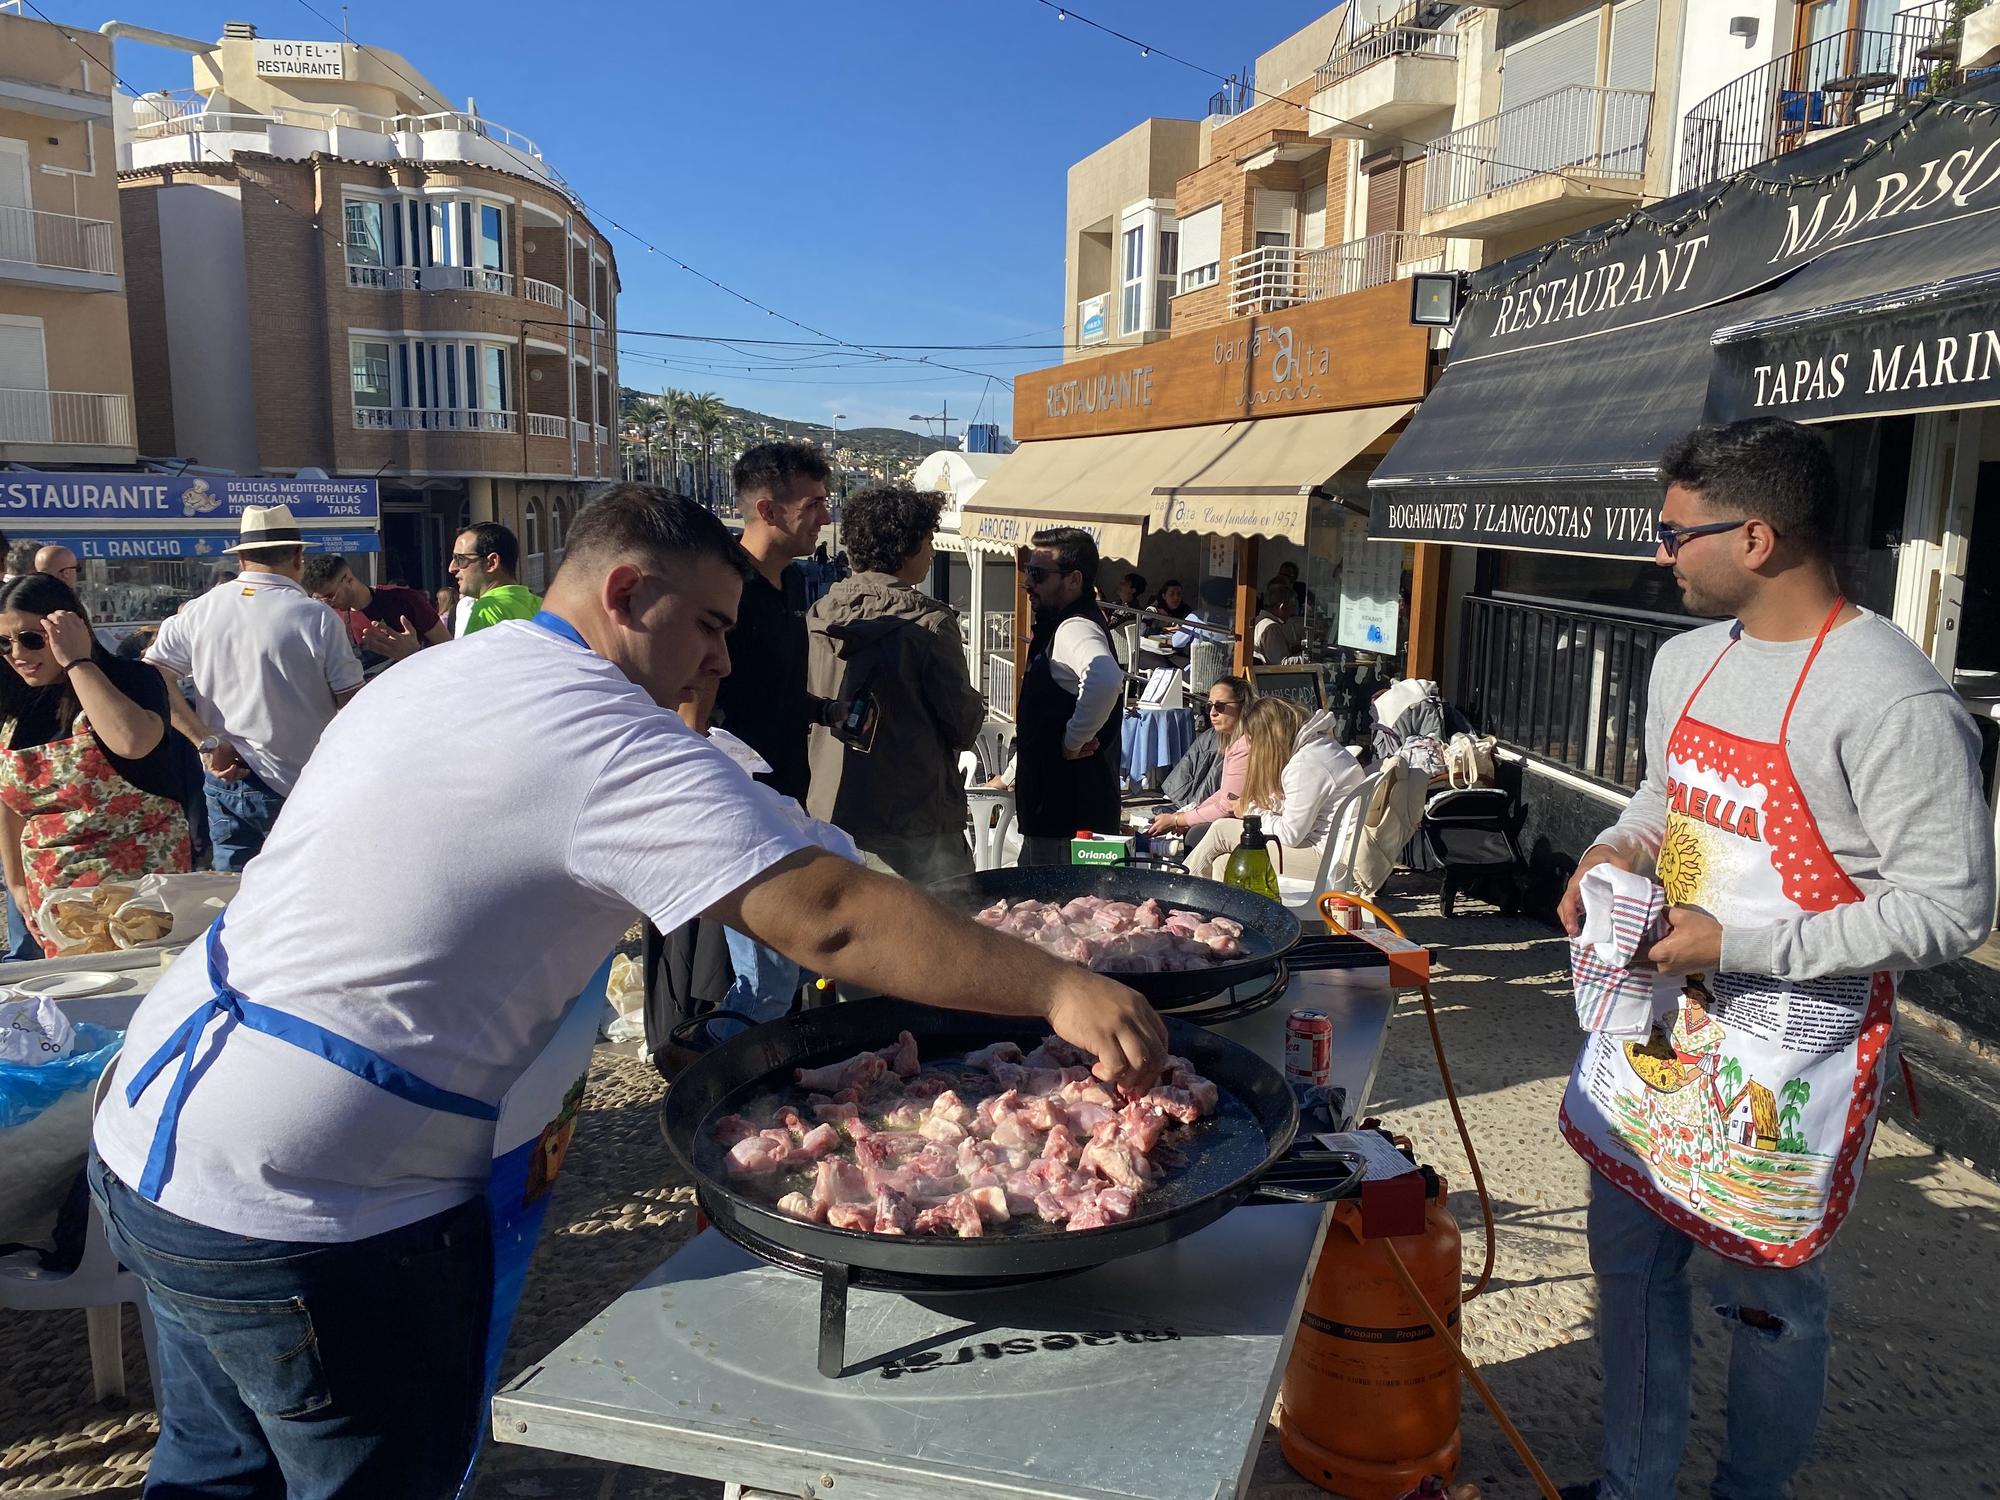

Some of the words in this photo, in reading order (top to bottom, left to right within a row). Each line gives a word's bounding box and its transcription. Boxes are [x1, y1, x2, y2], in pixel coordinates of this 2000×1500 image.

[273, 44, 322, 57] HOTEL
[257, 60, 340, 75] RESTAURANTE
[1489, 236, 1709, 338] RESTAURANT
[1214, 334, 1262, 365] barra
[1753, 353, 1848, 407] TAPAS
[1047, 367, 1154, 417] RESTAURANTE
[227, 482, 277, 492] DELICIAS
[280, 483, 368, 494] MEDITERRANEAS
[228, 494, 300, 504] MARISCADAS
[316, 495, 361, 504] PAELLAS
[328, 505, 361, 514] TAPAS
[1388, 503, 1467, 530] BOGAVANTES
[1272, 511, 1298, 527] 1952
[978, 517, 1020, 541] ARROCERIA
[1024, 521, 1031, 543] Y
[82, 541, 103, 557] EL
[108, 540, 181, 556] RANCHO
[1666, 776, 1761, 842] PAELLA
[1078, 850, 1118, 860] Orlando
[1344, 1327, 1383, 1340] Propano
